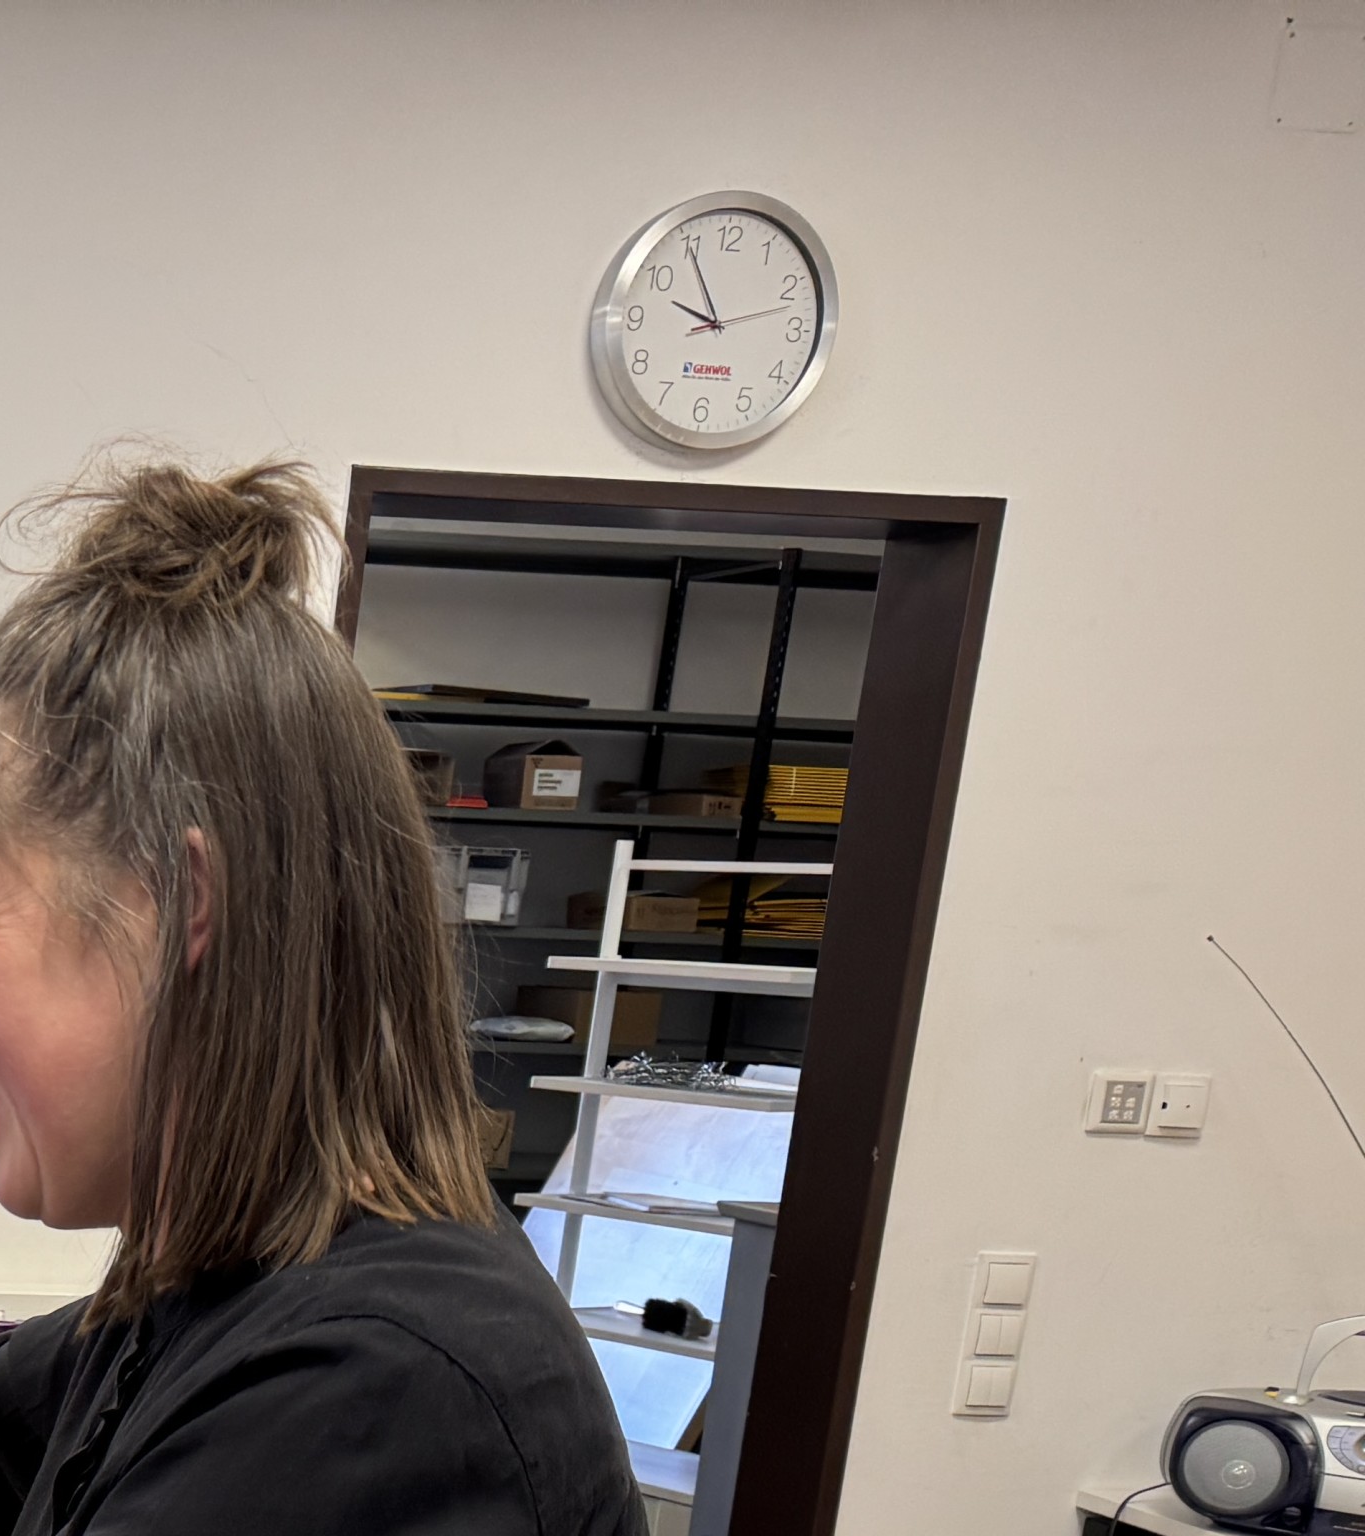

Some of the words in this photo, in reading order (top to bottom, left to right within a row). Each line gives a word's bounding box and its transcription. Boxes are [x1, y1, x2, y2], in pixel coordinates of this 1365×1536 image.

[681, 234, 701, 260] 11
[716, 225, 743, 252] 12
[761, 240, 771, 265] 1
[647, 264, 674, 291] 10
[780, 274, 797, 301] 2
[627, 305, 644, 331] 9
[785, 317, 803, 343] 3
[631, 349, 649, 375] 8
[693, 364, 732, 376] GEHWOL
[768, 360, 784, 384] 4
[659, 381, 674, 406] 7
[735, 387, 753, 412] 5
[693, 397, 710, 423] 6
